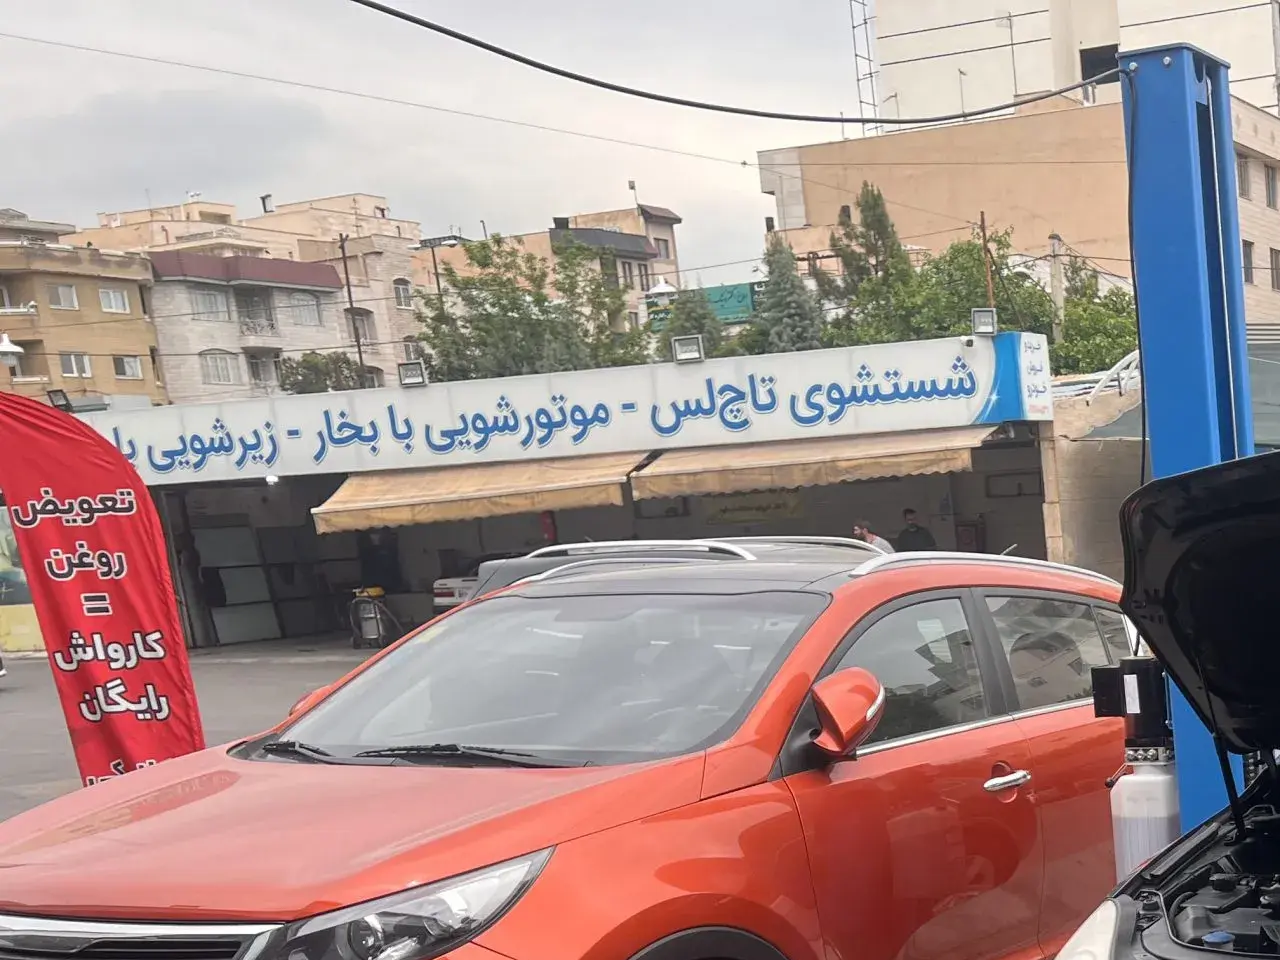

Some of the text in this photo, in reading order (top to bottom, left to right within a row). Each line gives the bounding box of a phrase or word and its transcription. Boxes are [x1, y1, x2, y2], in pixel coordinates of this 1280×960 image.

[790, 354, 977, 426] شستشوی
[147, 417, 280, 475] زیرشویی
[313, 408, 380, 464] بخار
[387, 403, 414, 453] با
[425, 393, 610, 453] موتورشویی
[11, 487, 136, 528] تعویض
[44, 541, 127, 580] روغن
[53, 630, 166, 671] کارواش
[79, 677, 170, 722] رایگان
